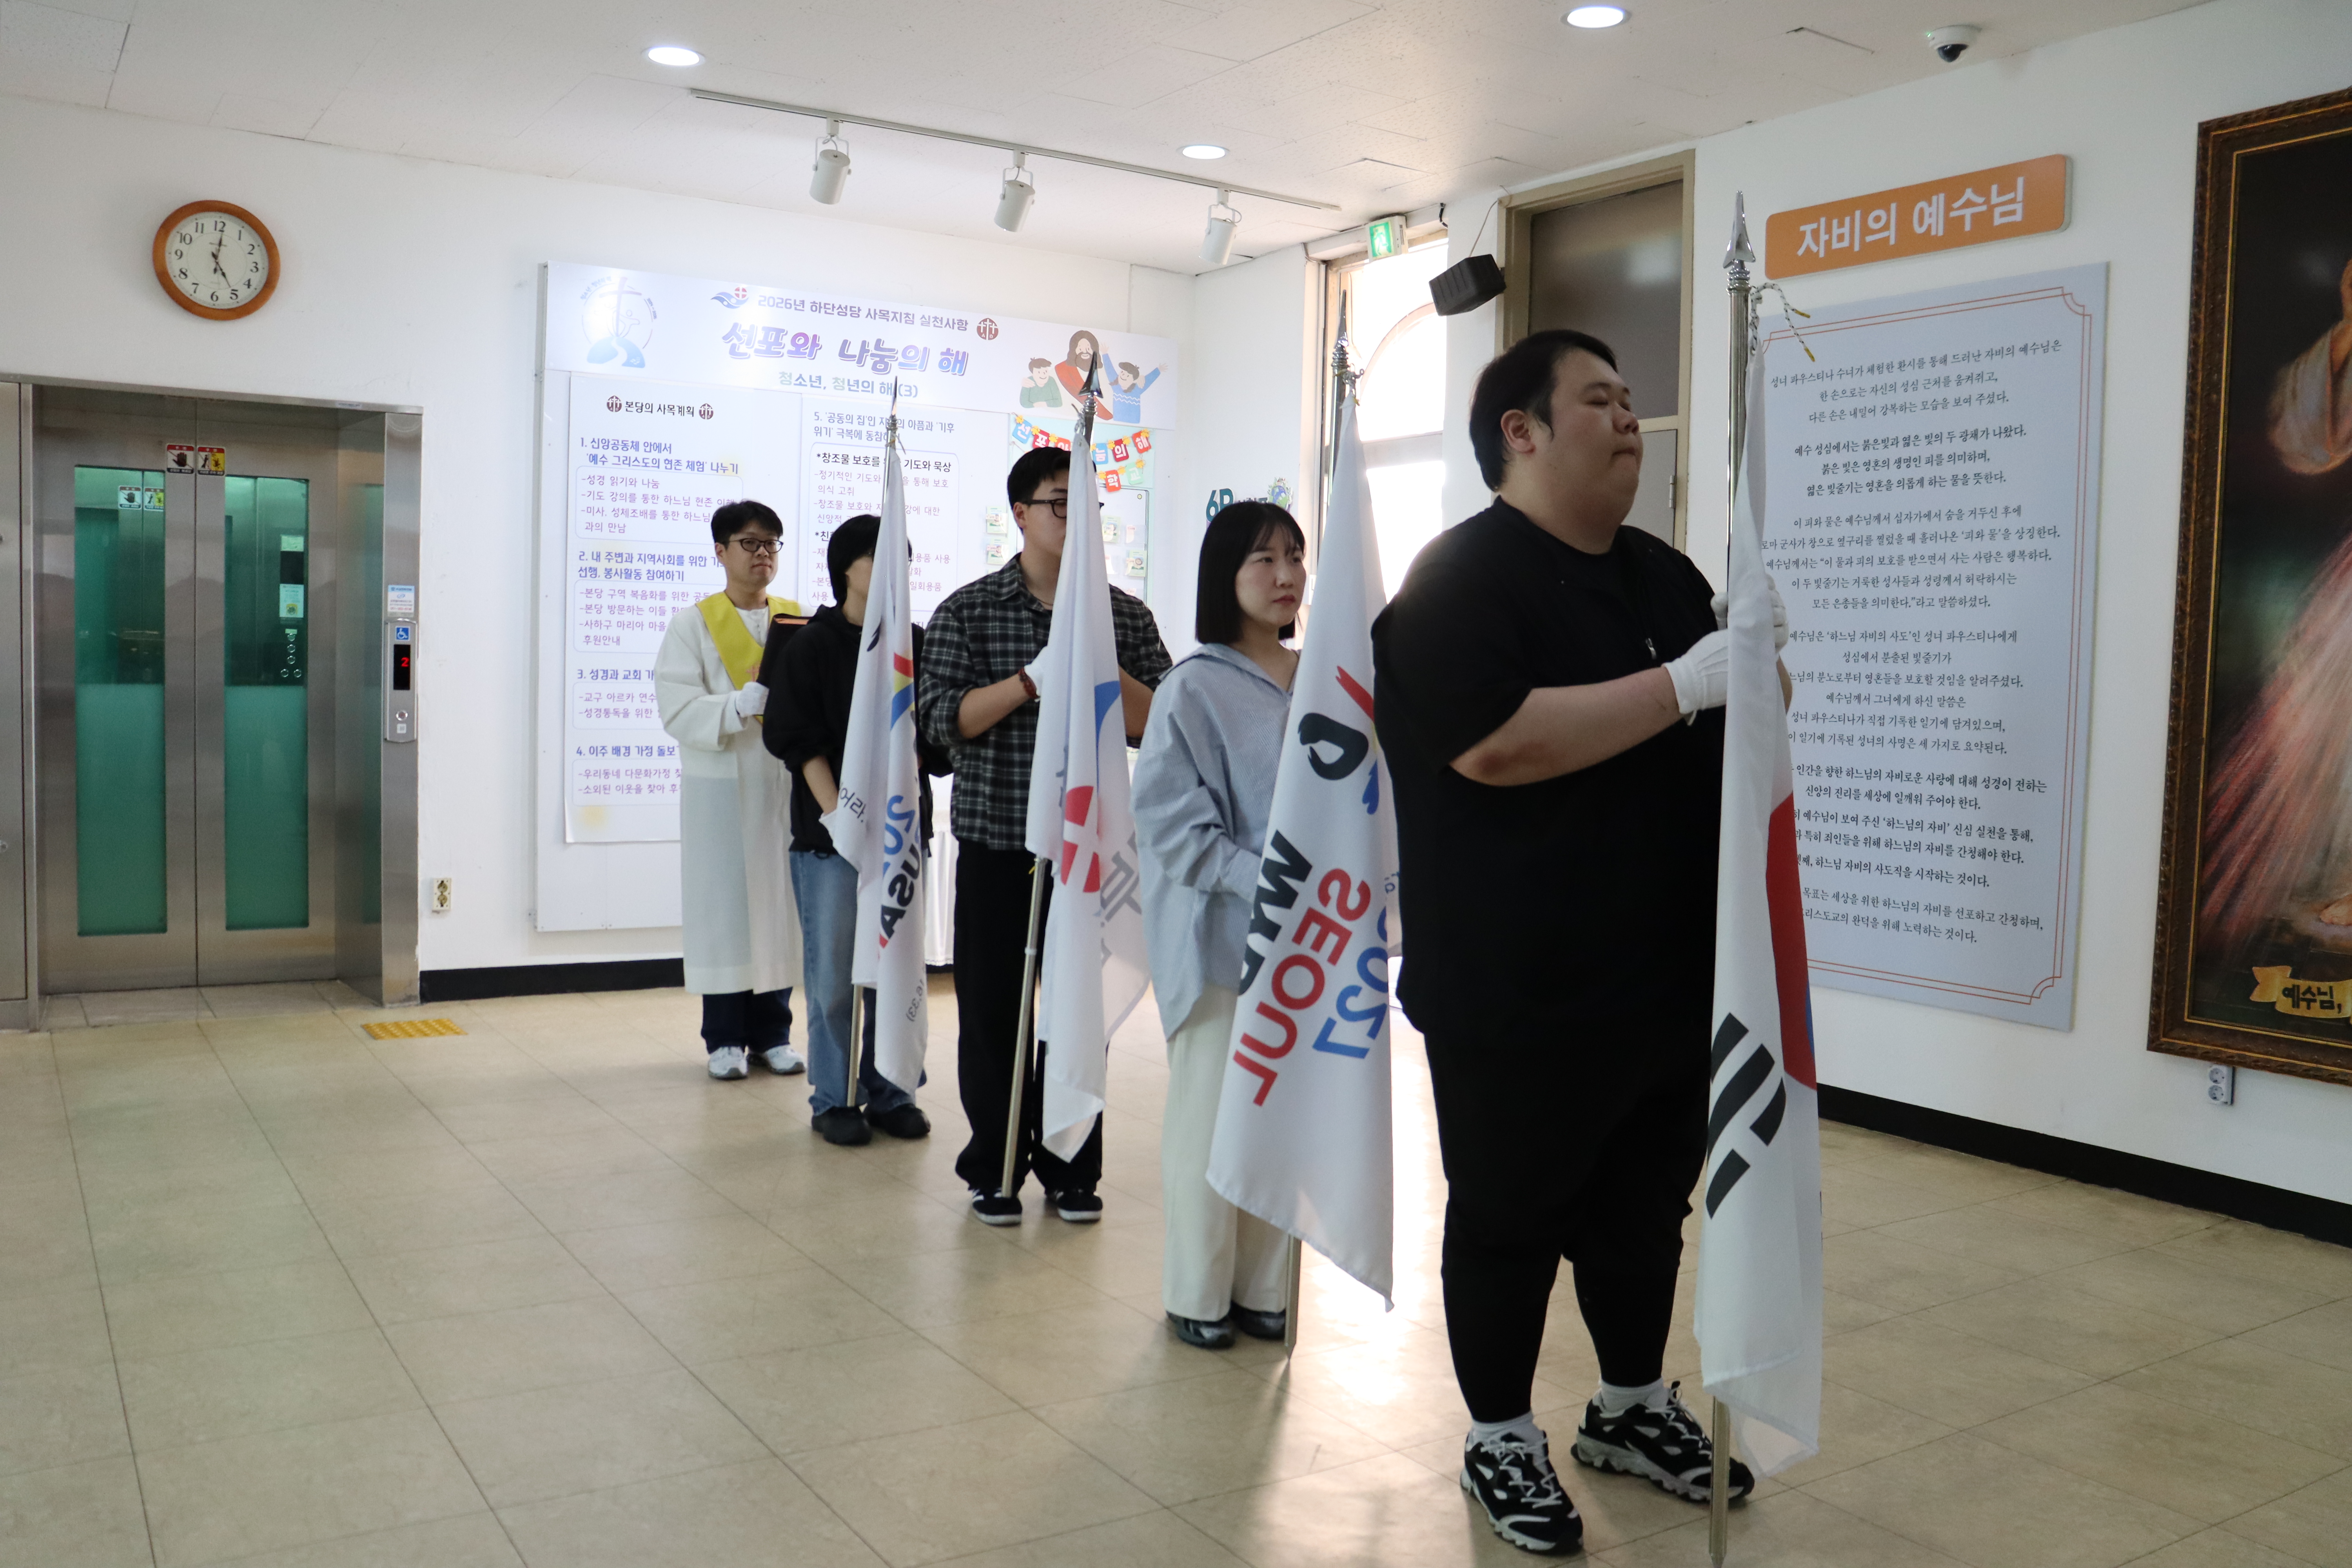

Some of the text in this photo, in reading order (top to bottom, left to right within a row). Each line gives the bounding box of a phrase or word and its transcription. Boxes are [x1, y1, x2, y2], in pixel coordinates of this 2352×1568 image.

[1797, 177, 2023, 257] 자비의 예수님
[195, 222, 204, 234] 11
[214, 221, 226, 232] 12
[179, 233, 192, 245] 10
[238, 230, 242, 240] 1
[174, 249, 183, 260] 9
[247, 244, 254, 255] 2
[178, 268, 188, 279] 8
[250, 261, 259, 273] 3
[192, 282, 199, 293] 7
[243, 278, 252, 289] 4
[211, 291, 218, 301] 6
[230, 289, 238, 300] 5
[758, 295, 969, 332] 2026년 하단성당 사목지침 실천사항
[722, 322, 969, 376] 선포와 나눔의 해
[1771, 339, 2062, 388] 성녀 파우스티나 수녀가 체험한 환시를 통해 드러난 자비의 예수님은
[779, 371, 826, 390] 청소년,
[832, 376, 874, 394] 청년의
[898, 383, 918, 398] (3)
[625, 401, 694, 417] 본당의 사목계획
[814, 412, 955, 433] 5. '공동의 집'인 아픔과 '기후
[814, 426, 862, 440] 위기' 극복에
[590, 437, 639, 452] 신앙공동체
[643, 441, 671, 454] 안에서
[1795, 424, 2027, 457] 예수 성심에서는 붉은빛과 엷은 빛의 두 광채가 나왔다.
[612, 455, 660, 469] 그리스도의
[664, 458, 683, 471] 현존
[710, 462, 738, 474] 나누기
[852, 455, 951, 472] 보호를 기도와 묵상
[610, 476, 638, 488] 읽기와
[642, 478, 660, 489] 나눔
[818, 485, 854, 496] 의식 고취
[610, 492, 637, 503] 강의를
[641, 494, 660, 505] 통한
[664, 495, 690, 506] 하느님
[695, 497, 713, 508] 현존
[611, 507, 658, 520] 성체조배를
[661, 510, 680, 521] 통한
[684, 511, 710, 523] 하느님
[584, 521, 627, 534] 과의 만남
[1761, 525, 2060, 552] 로마 군사가 창으로 옆구리를 찔렀을 때 흘러나온 ‘피와 물’을 상징한다.
[579, 551, 708, 567] 2. 내 주변과 지역사회를 위한
[604, 567, 642, 581] 봉사활동
[646, 569, 684, 582] 참여하기
[1812, 595, 1991, 609] 모든 은총들을 의미한다.”라고 말씀하셨다.
[616, 620, 644, 631] 마리아
[583, 634, 621, 646] 후원안내
[401, 657, 410, 667] 2
[1842, 651, 1952, 664] 성심에서 분출된 빛줄기가
[577, 669, 641, 681] 3. 성경과 교회
[1826, 692, 1966, 708] 예수님께서 그녀에게 하신 말씀은
[1792, 711, 2005, 733] 성녀 파우스티나가 직접 기록한 일기에 담겨있으며,
[576, 746, 653, 757] 4. 이주 배경 가정
[624, 768, 670, 779] 다문화가정
[615, 784, 643, 795] 이웃을
[647, 784, 666, 794] 찾아
[1806, 785, 1981, 810] 신앙의 진리를 세상에 일깨워 주어야 한다.
[1803, 887, 2043, 931] 목표는 세상을 위한 하느님의 자비를 선포하고 간청하며,
[2282, 984, 2341, 1014] 예수님,
